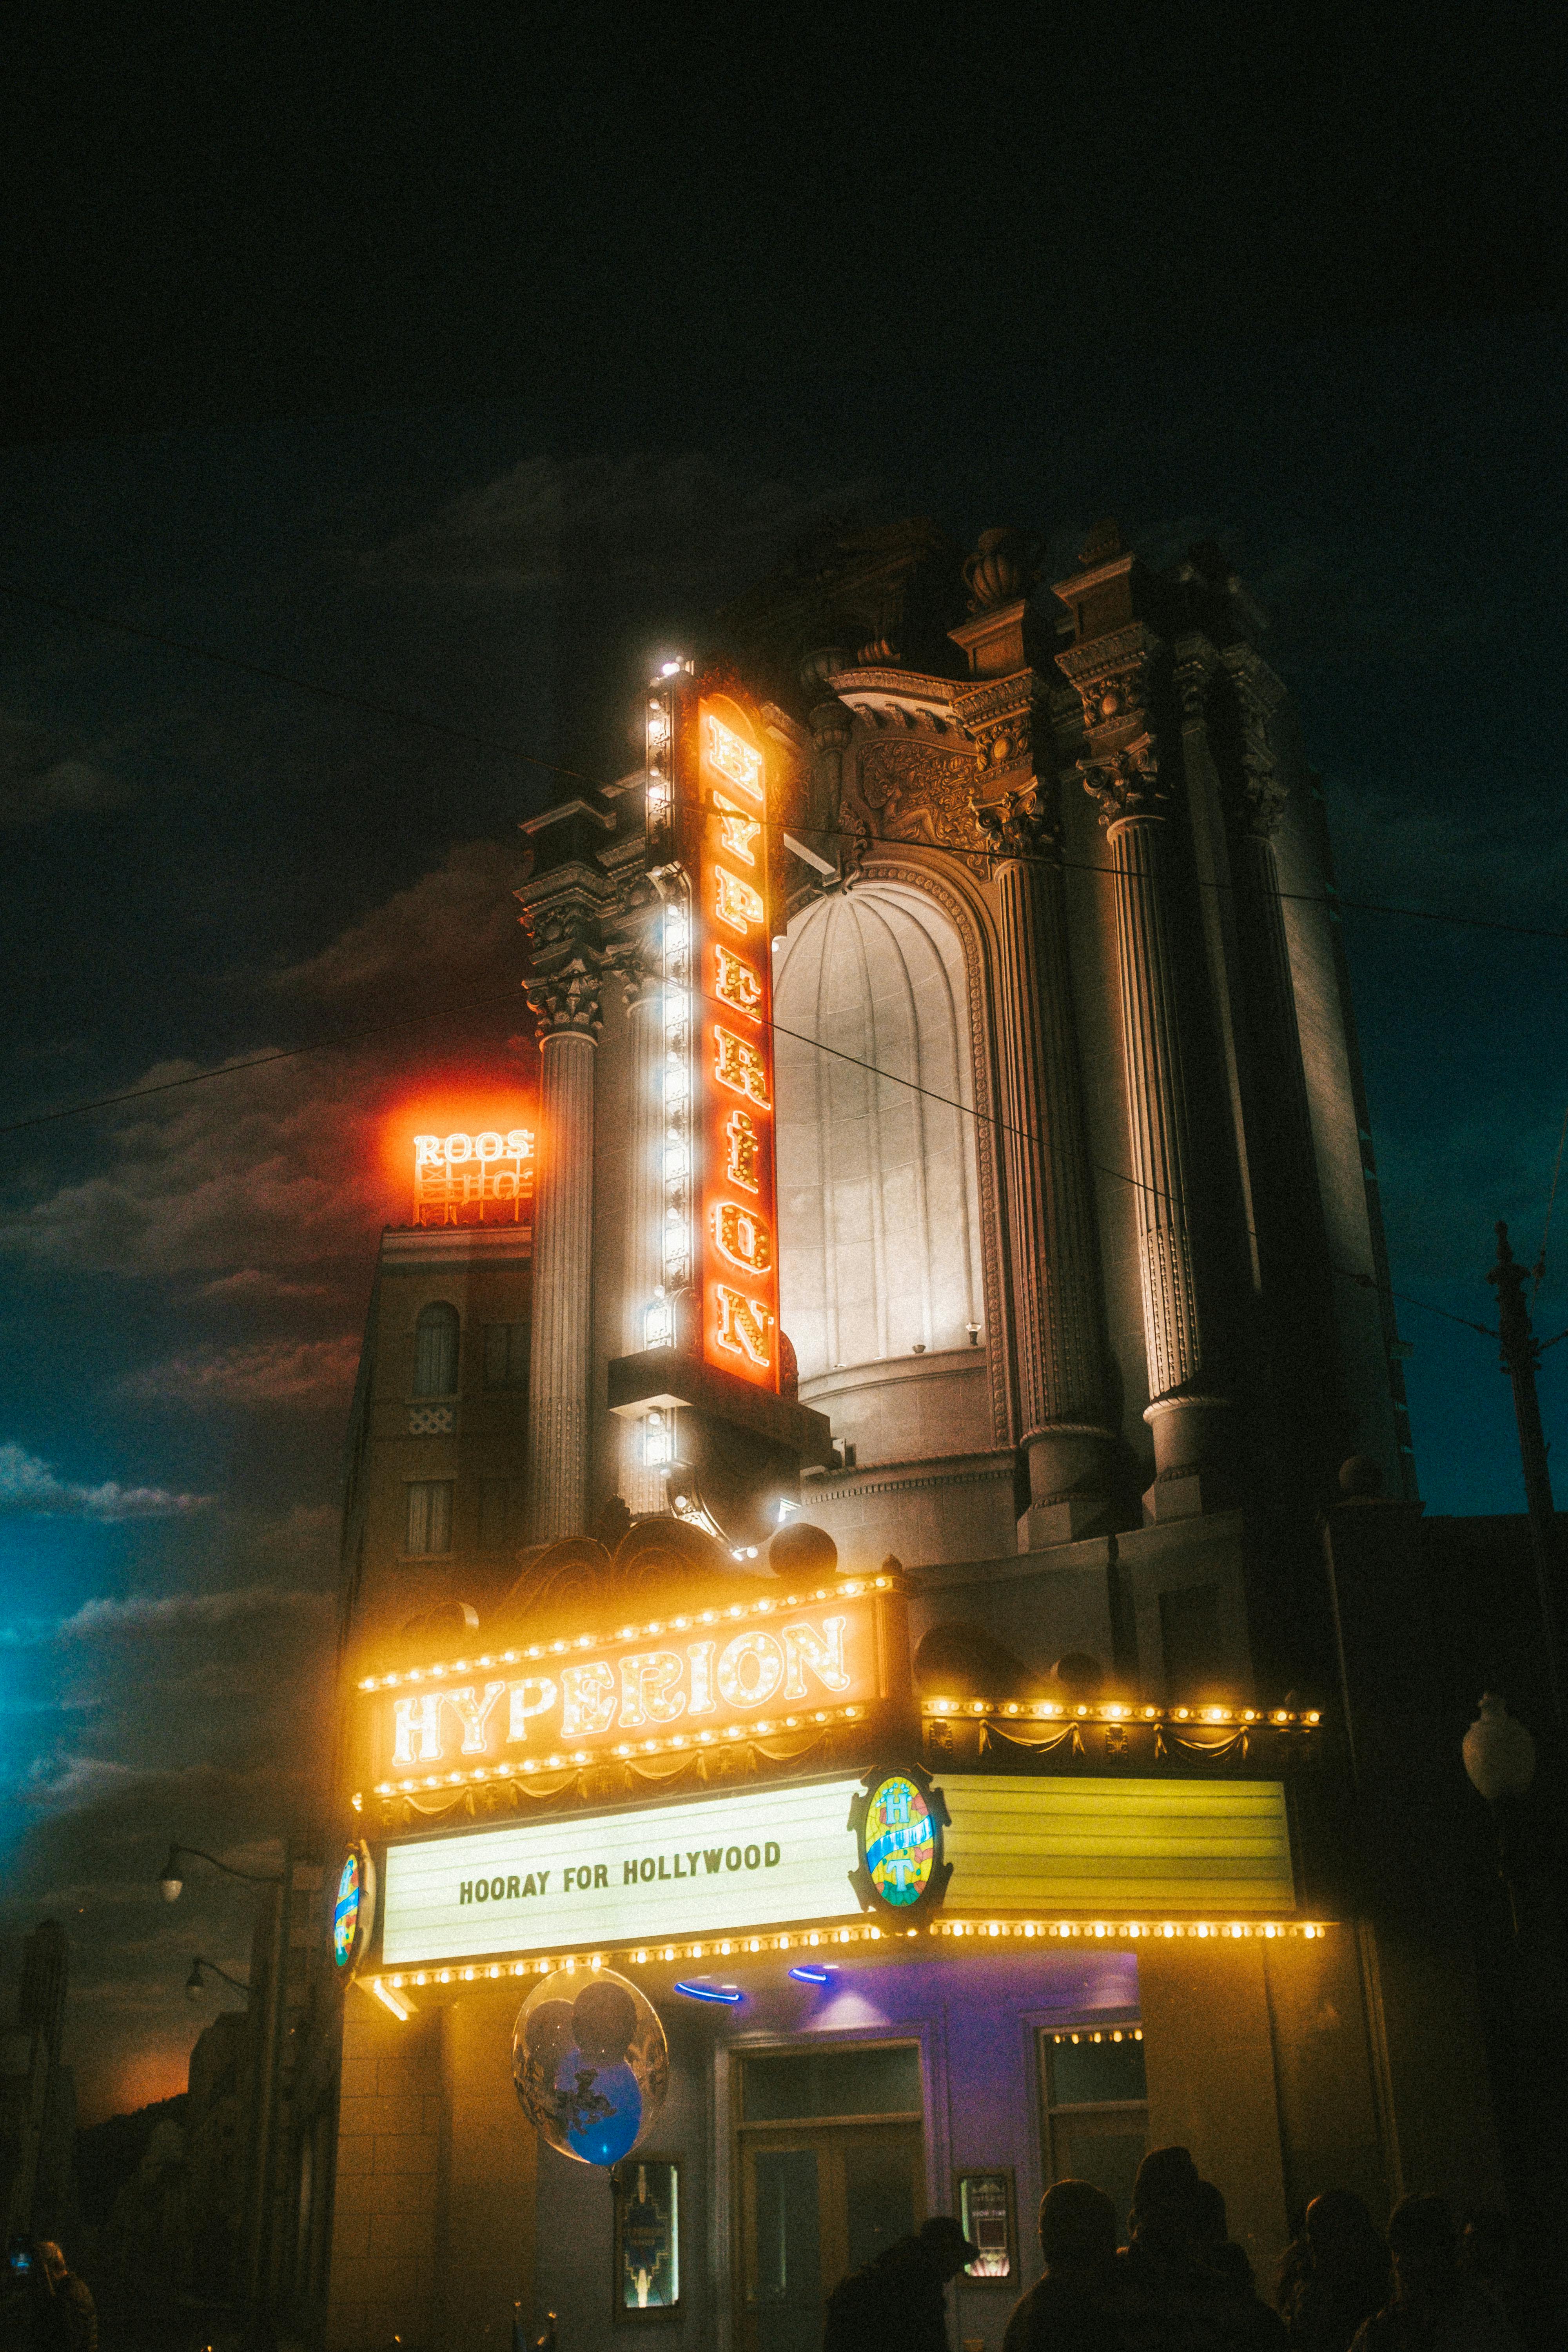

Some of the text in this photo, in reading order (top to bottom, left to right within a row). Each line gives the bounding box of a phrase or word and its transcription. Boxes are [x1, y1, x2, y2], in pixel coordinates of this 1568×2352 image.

[414, 1129, 529, 1165] ROOS
[392, 1616, 850, 1766] HYPERION
[886, 1793, 909, 1824] H
[460, 1842, 780, 1905] HOORAY FOR HOLLYWOOD
[886, 1859, 914, 1892] T
